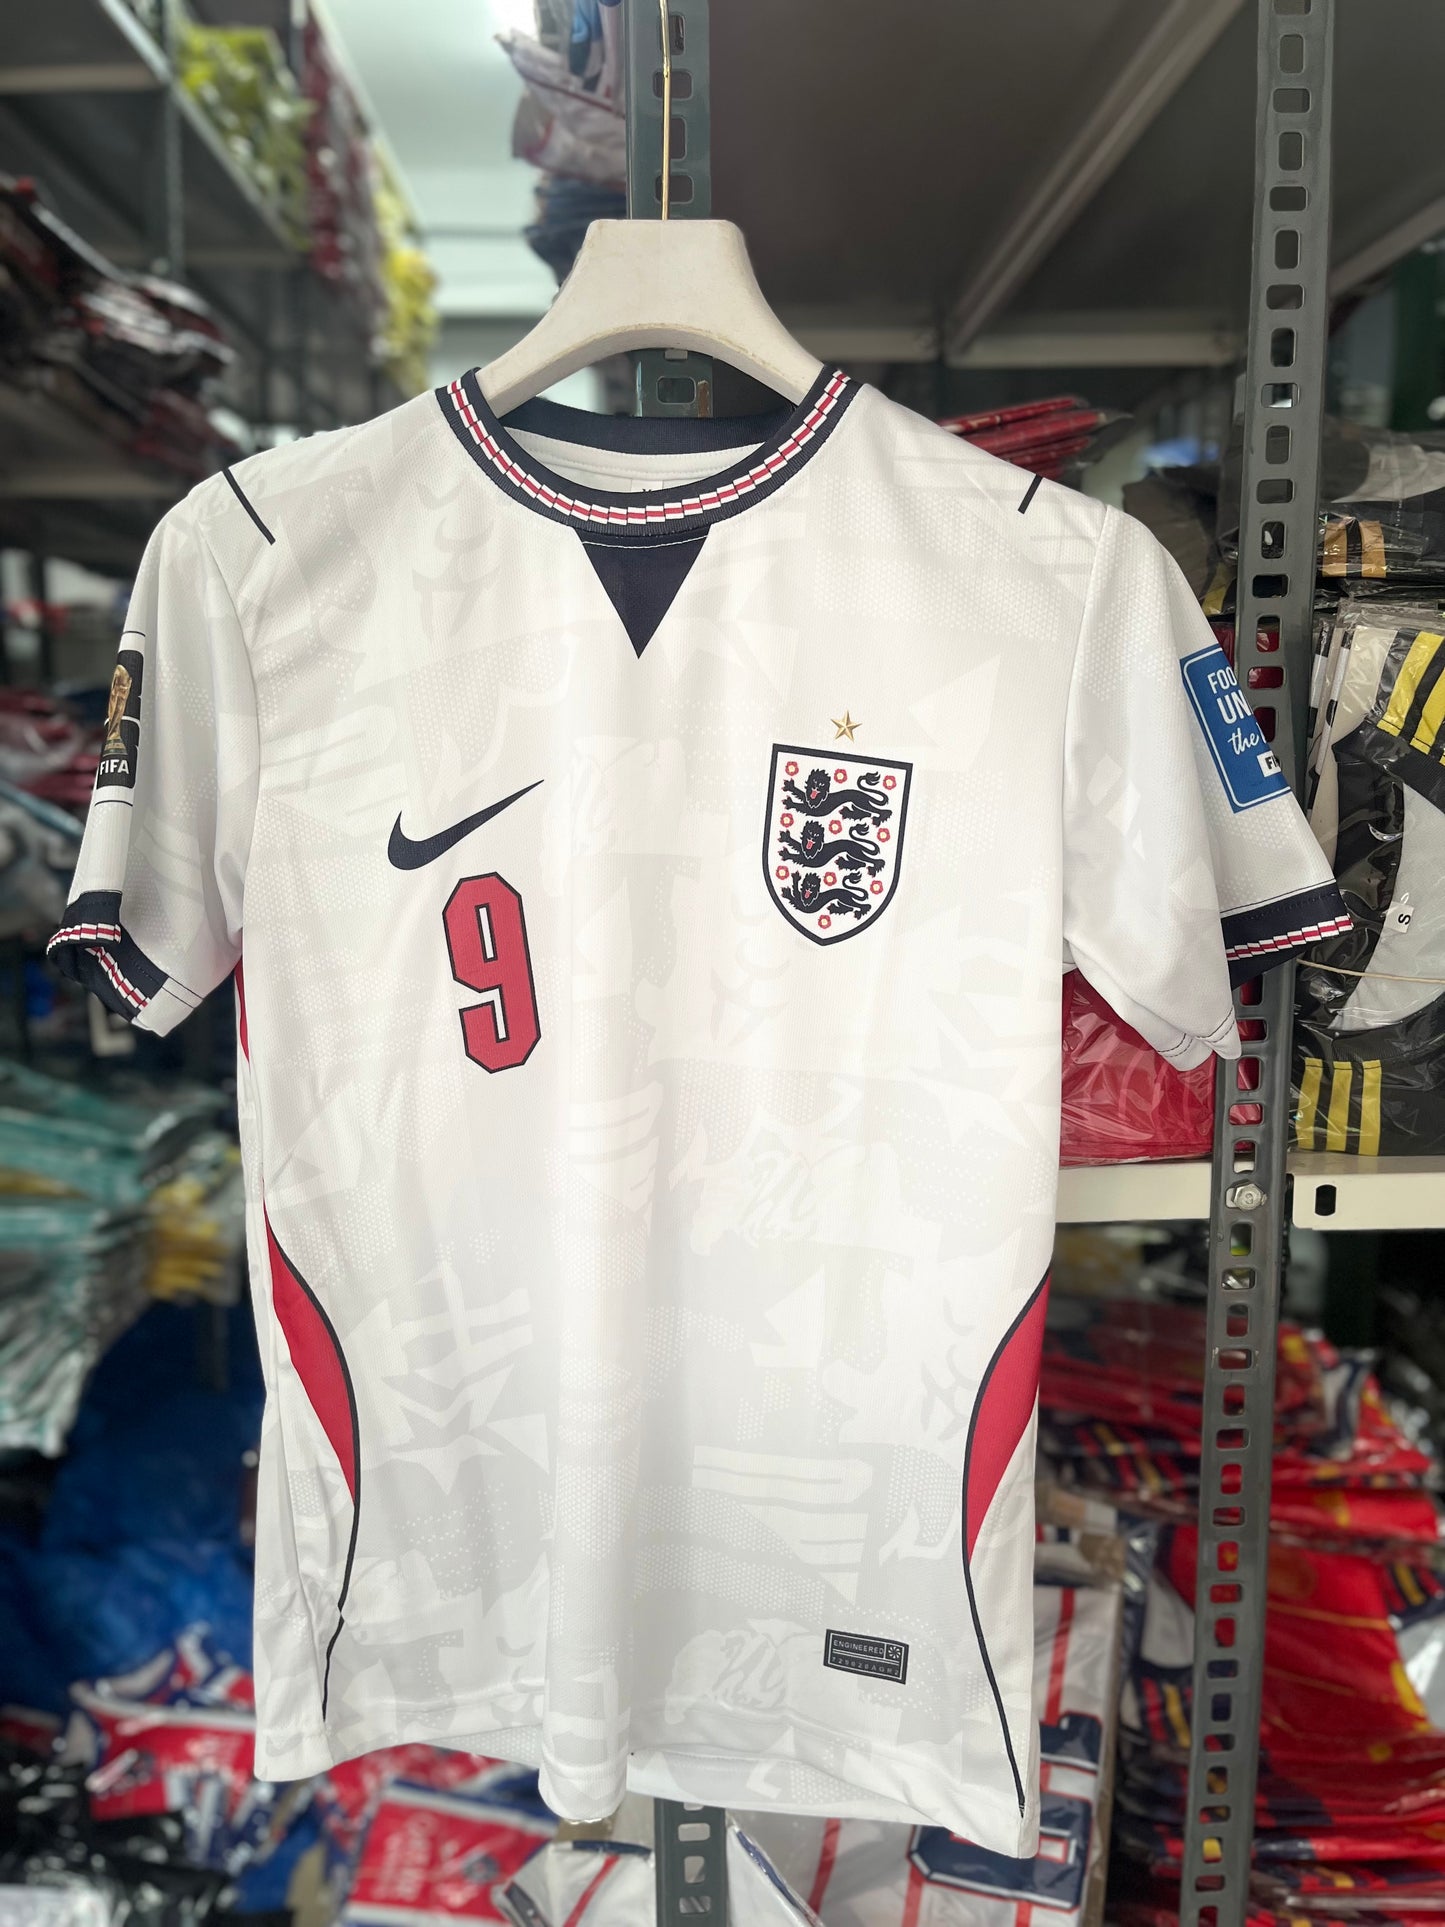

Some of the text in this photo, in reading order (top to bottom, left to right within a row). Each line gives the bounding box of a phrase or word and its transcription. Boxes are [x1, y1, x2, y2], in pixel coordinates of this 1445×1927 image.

[1216, 689, 1254, 724] UN
[1227, 727, 1260, 755] the
[99, 759, 130, 776] FIFA
[1397, 913, 1411, 926] S
[442, 871, 542, 1074] 9
[833, 1639, 885, 1655] ENGINEERED
